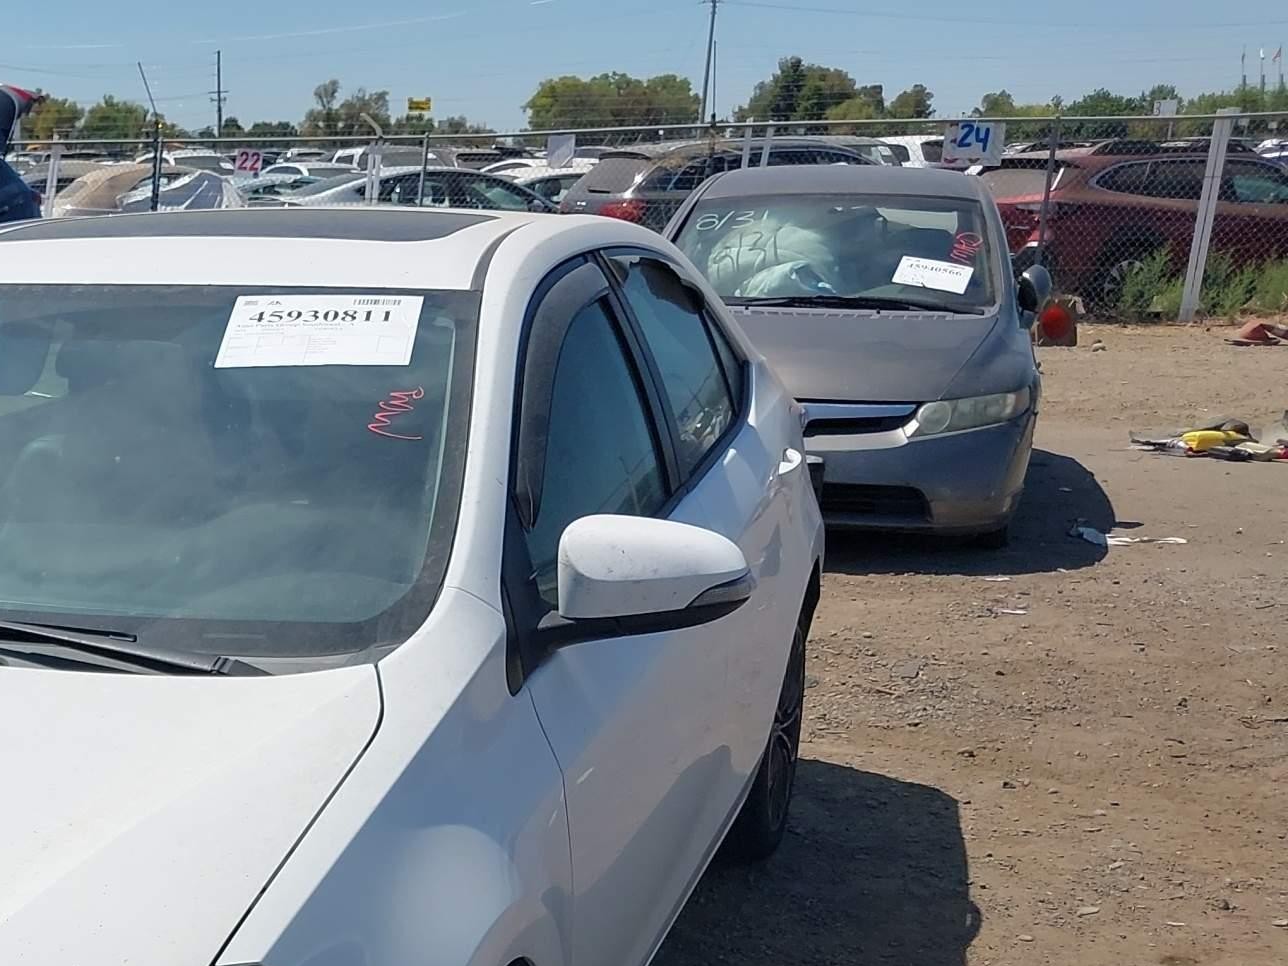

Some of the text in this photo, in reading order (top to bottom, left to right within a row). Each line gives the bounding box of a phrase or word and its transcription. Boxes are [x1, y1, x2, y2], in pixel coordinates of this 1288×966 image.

[958, 123, 990, 152] 24
[238, 151, 261, 171] 22
[248, 309, 393, 323] 45930811
